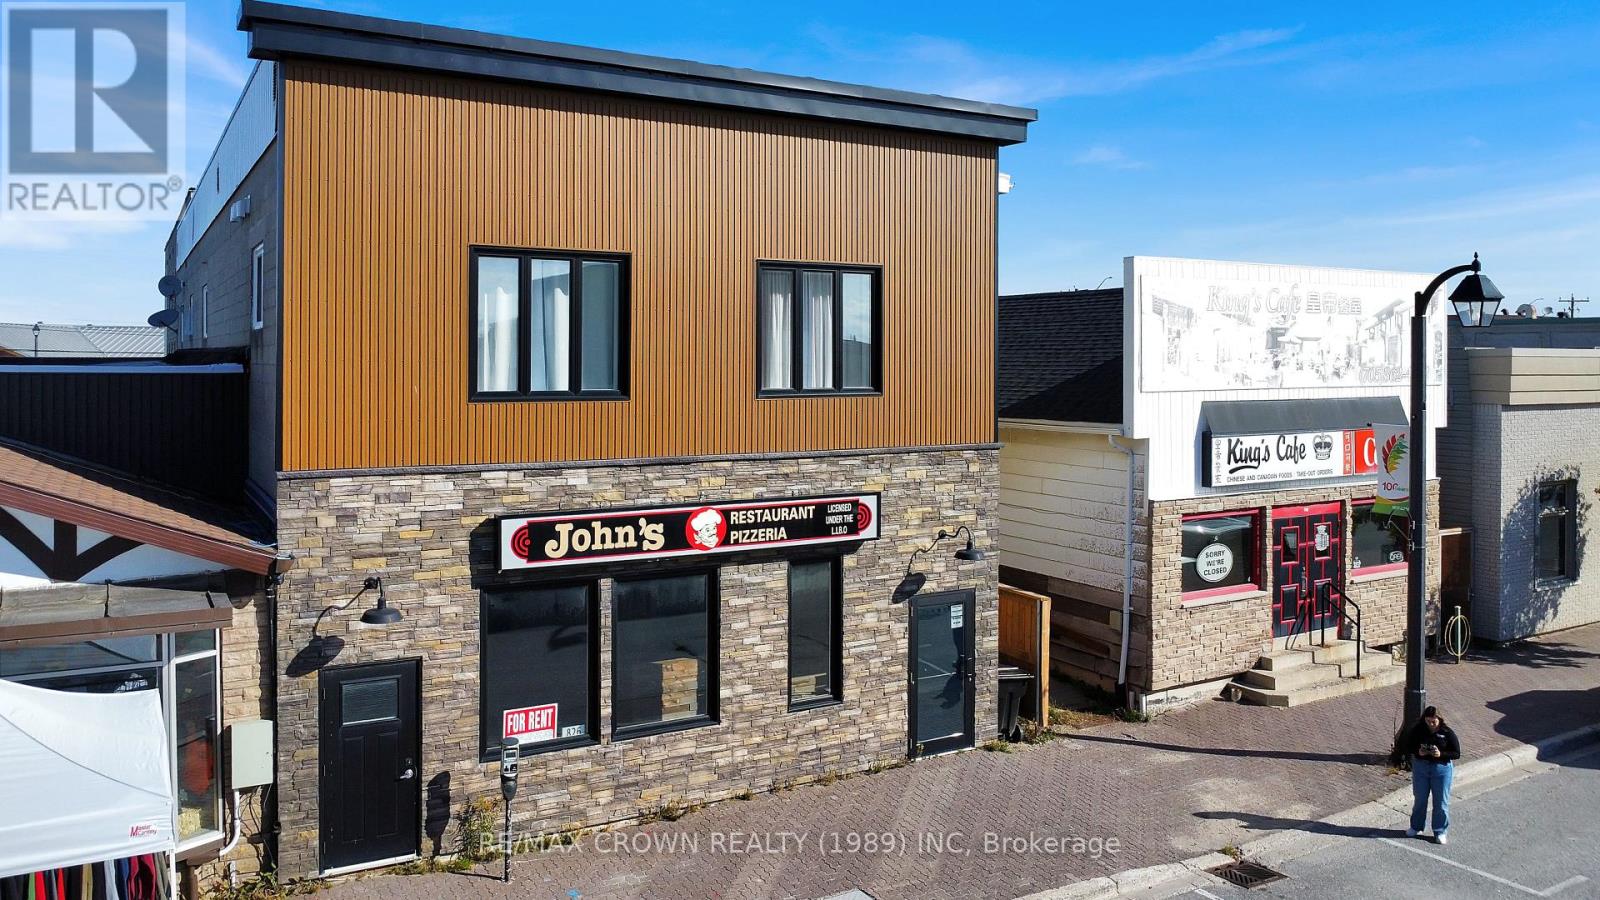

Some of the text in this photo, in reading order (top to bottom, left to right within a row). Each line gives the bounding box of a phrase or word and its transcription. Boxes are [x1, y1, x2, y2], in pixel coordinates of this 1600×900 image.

[1206, 285, 1261, 325] King's
[1227, 438, 1270, 474] King's
[1276, 434, 1306, 464] Cafe
[1226, 475, 1245, 483] CHINESE
[827, 502, 852, 513] LICENSED
[730, 505, 815, 525] RESTAURANT
[825, 513, 854, 525] UNDER THE
[544, 517, 665, 559] John's
[730, 527, 787, 544] PIZZERIA
[1205, 550, 1226, 558] SORRY
[1206, 559, 1225, 567] WE'RE
[1203, 567, 1227, 576] CLOSED
[507, 709, 553, 733] FOR RENT
